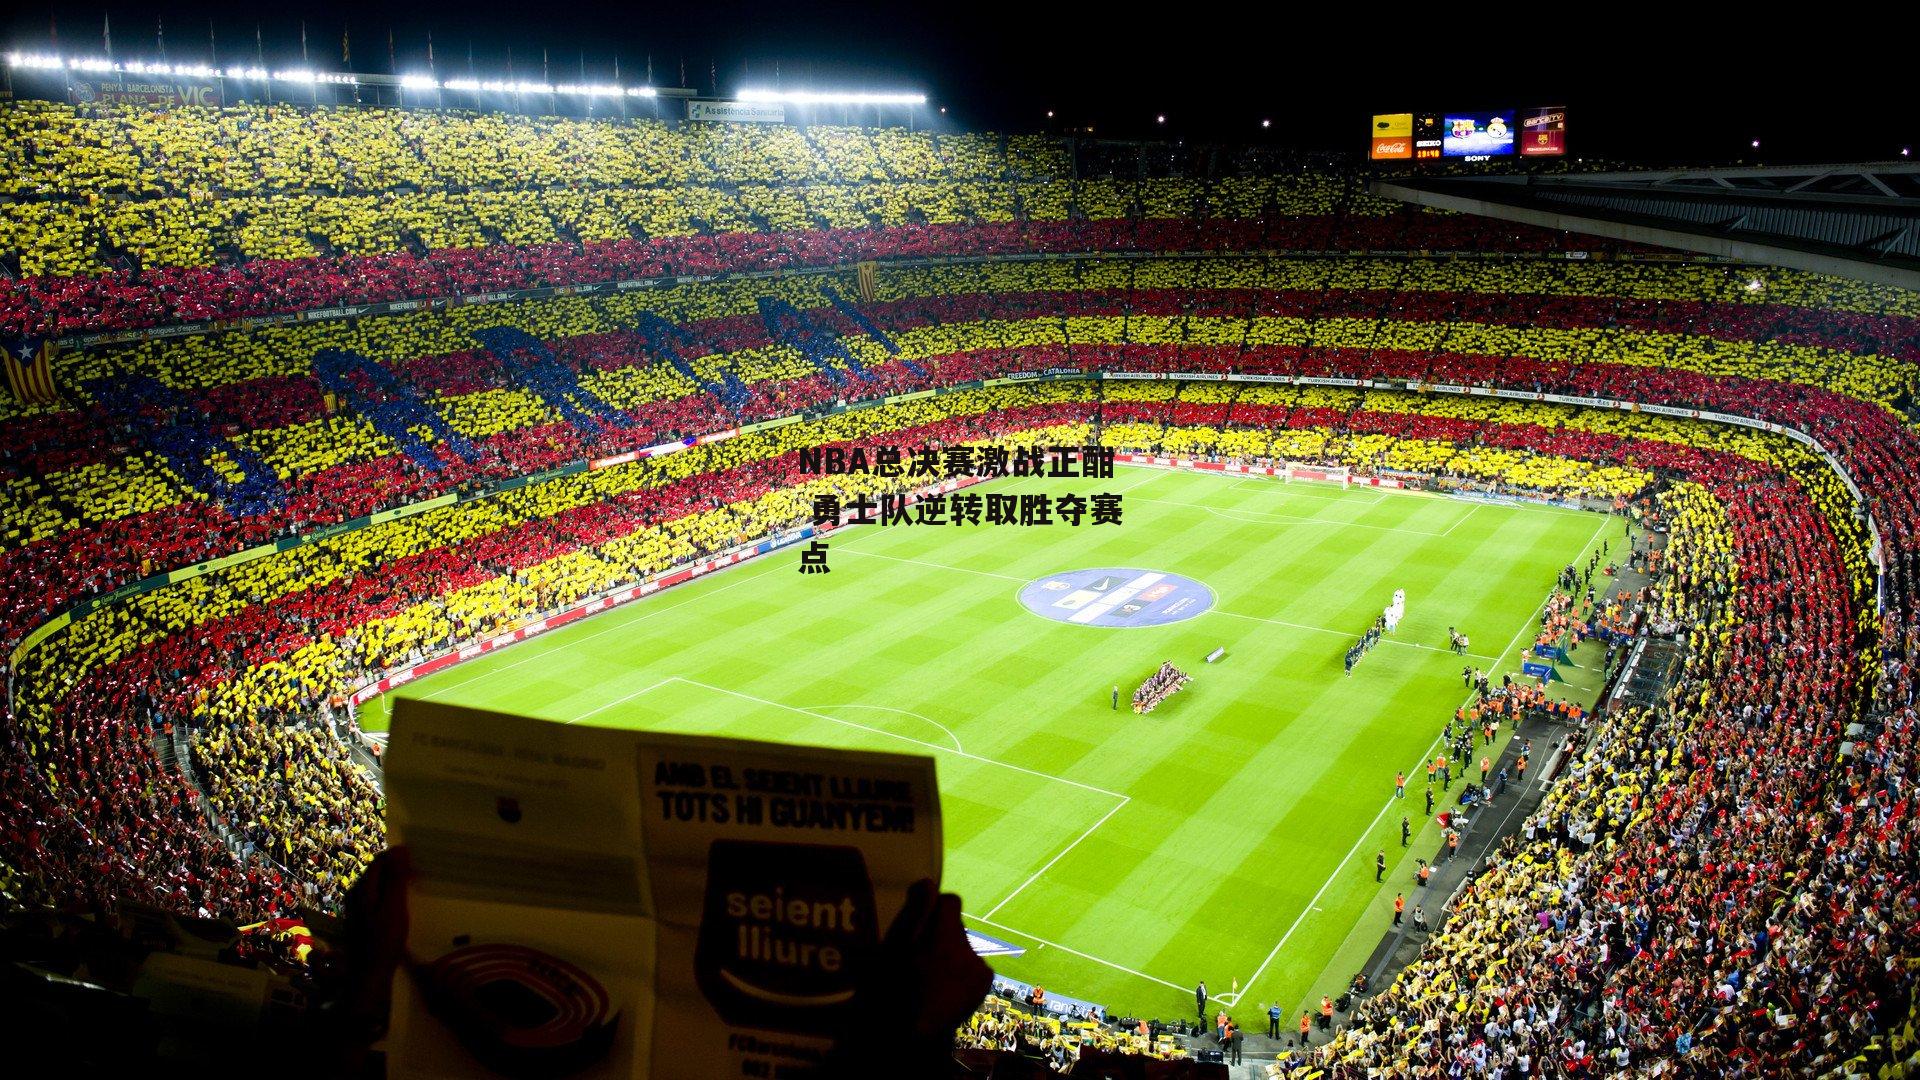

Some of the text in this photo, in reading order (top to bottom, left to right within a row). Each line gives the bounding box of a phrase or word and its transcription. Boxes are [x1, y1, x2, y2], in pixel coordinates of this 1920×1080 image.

[101, 83, 124, 92] PENYA
[177, 86, 214, 106] VIC
[307, 307, 358, 320] NIKEFOOTBALL.COM
[1007, 371, 1038, 381] FREEDOM
[1043, 367, 1081, 377] CATALONIA
[1558, 396, 1583, 404] TURKISH
[1662, 408, 1689, 416] AIRLINES
[1714, 413, 1764, 429] TURKISH AIRLINES
[654, 762, 706, 788] AMB
[711, 765, 739, 789] EL
[657, 791, 730, 824] TOTS
[736, 796, 763, 825] HI
[726, 884, 857, 934] seient
[738, 924, 844, 974] lliure
